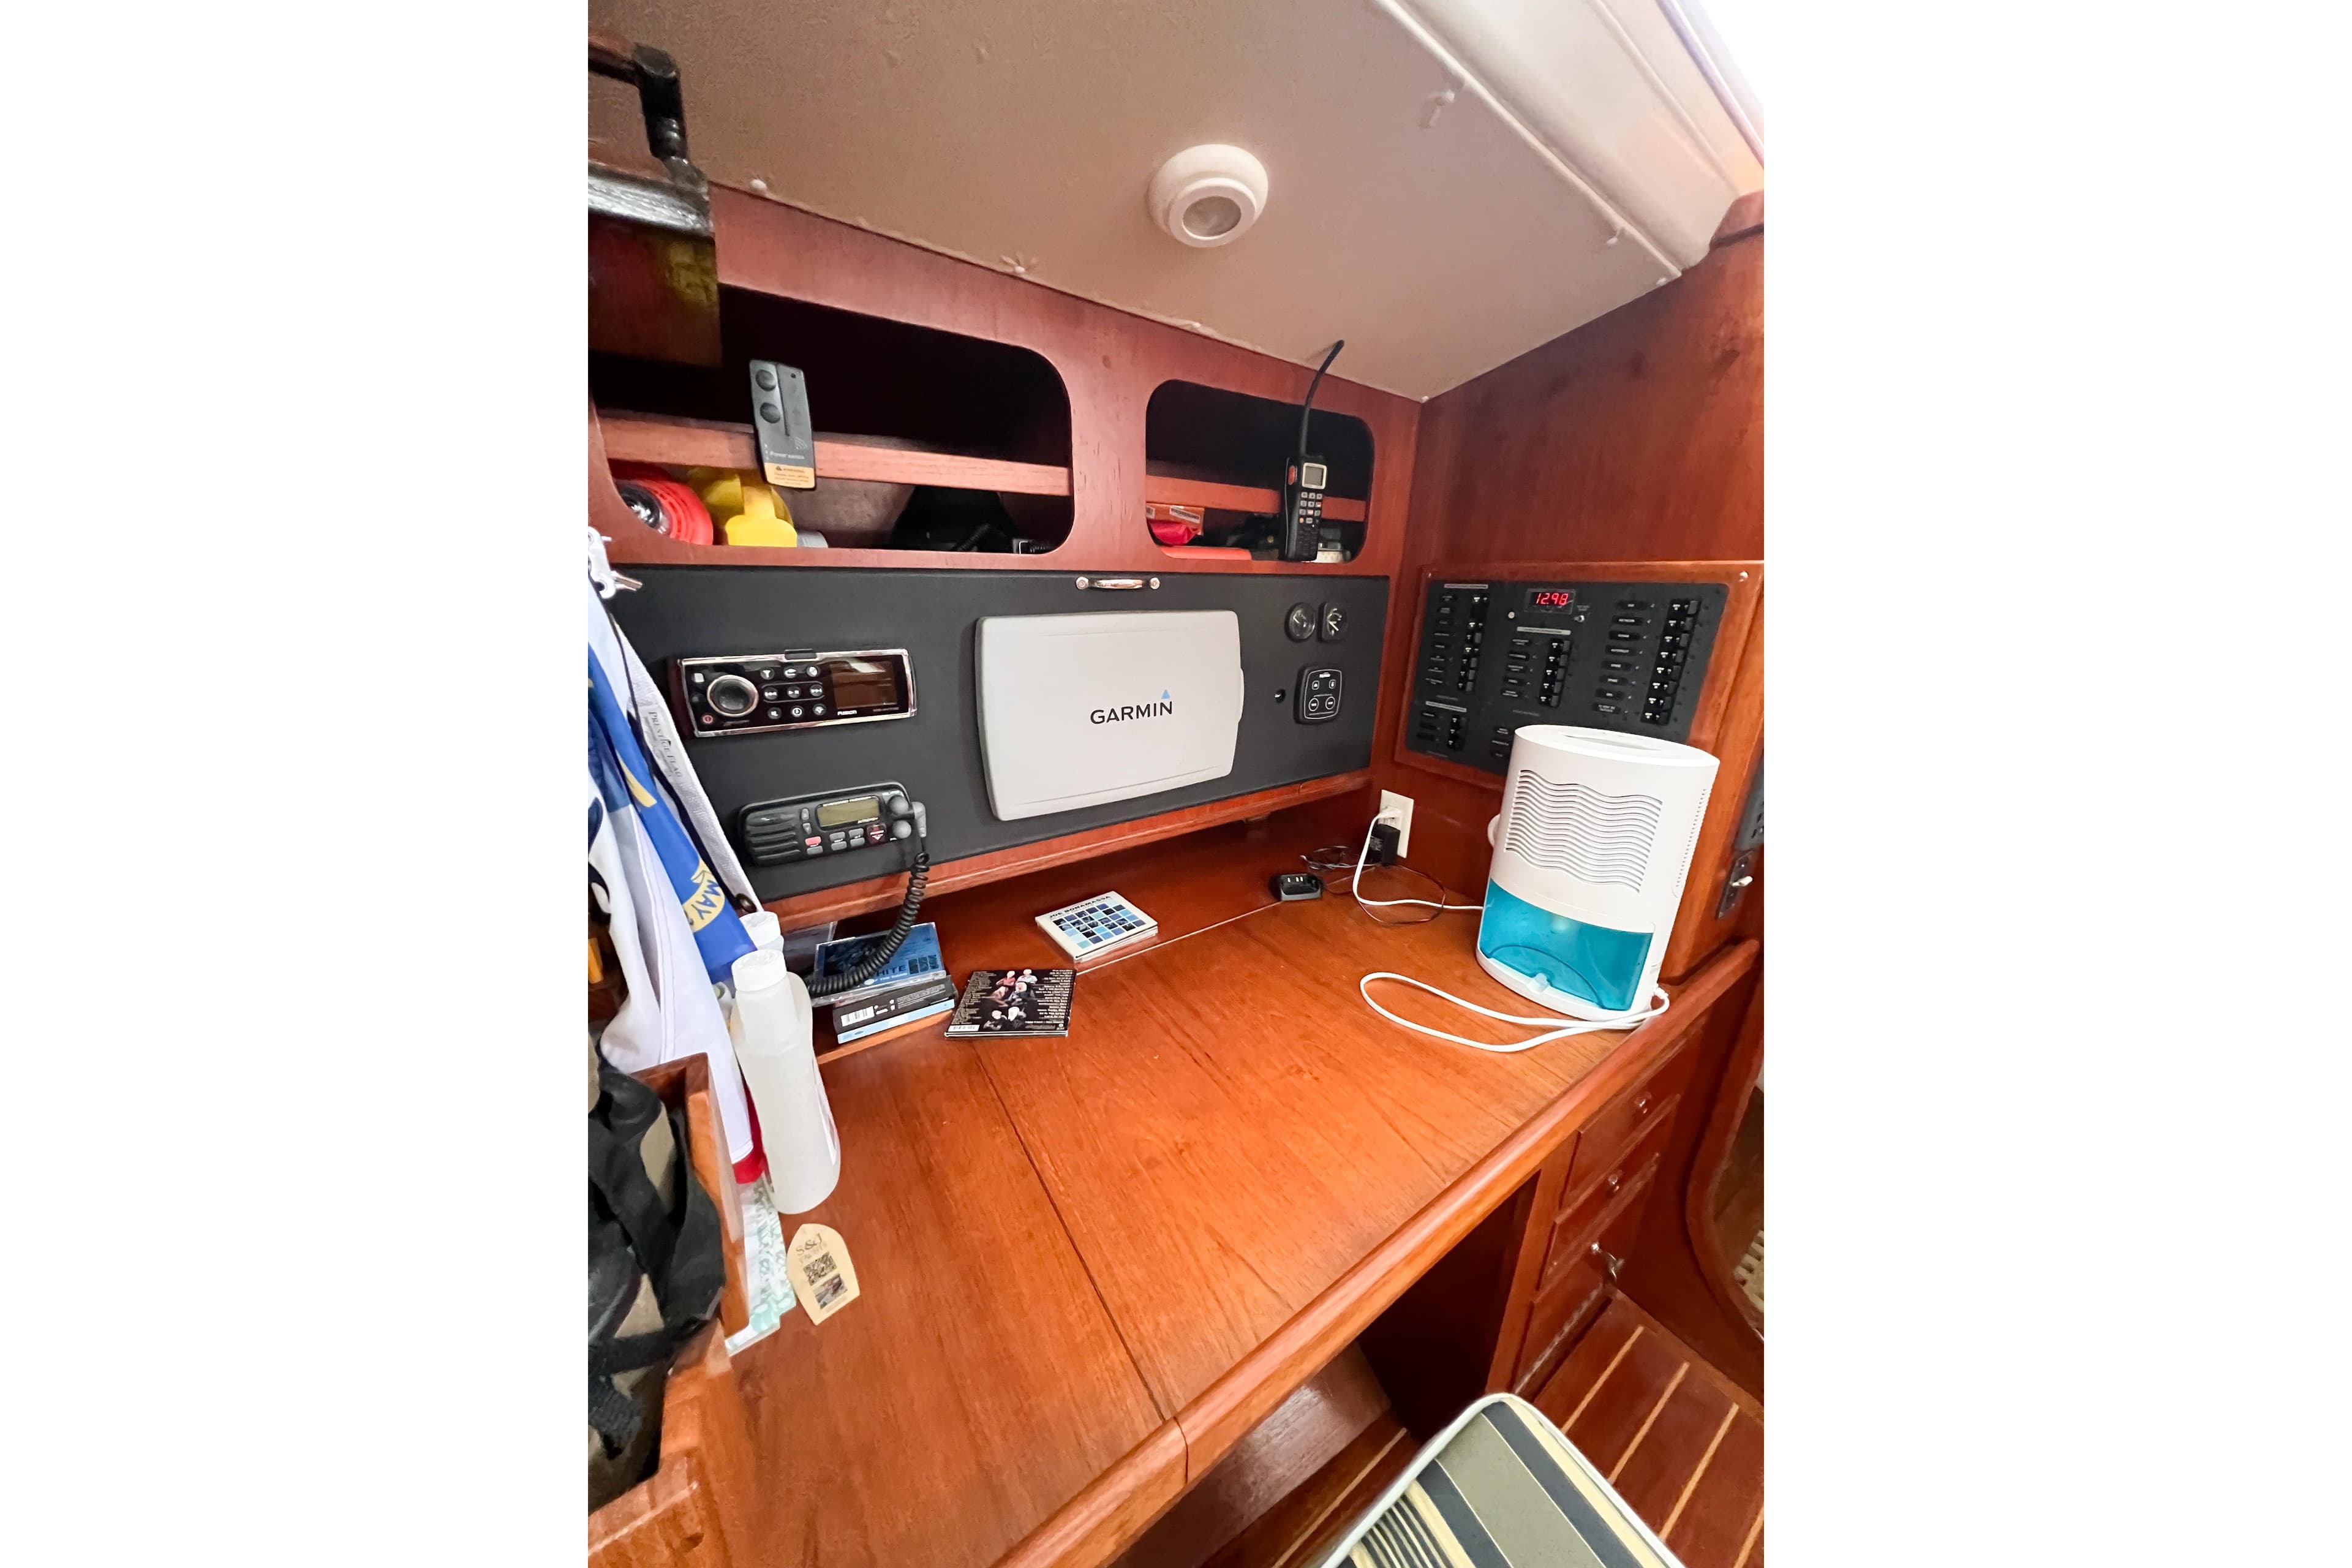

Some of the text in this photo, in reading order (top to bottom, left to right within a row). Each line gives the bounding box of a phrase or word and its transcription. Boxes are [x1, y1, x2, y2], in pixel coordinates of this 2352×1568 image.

[1090, 701, 1172, 725] GARMIN
[690, 878, 722, 920] MAY
[1064, 895, 1111, 913] BONAMASSA
[876, 965, 907, 977] HITE
